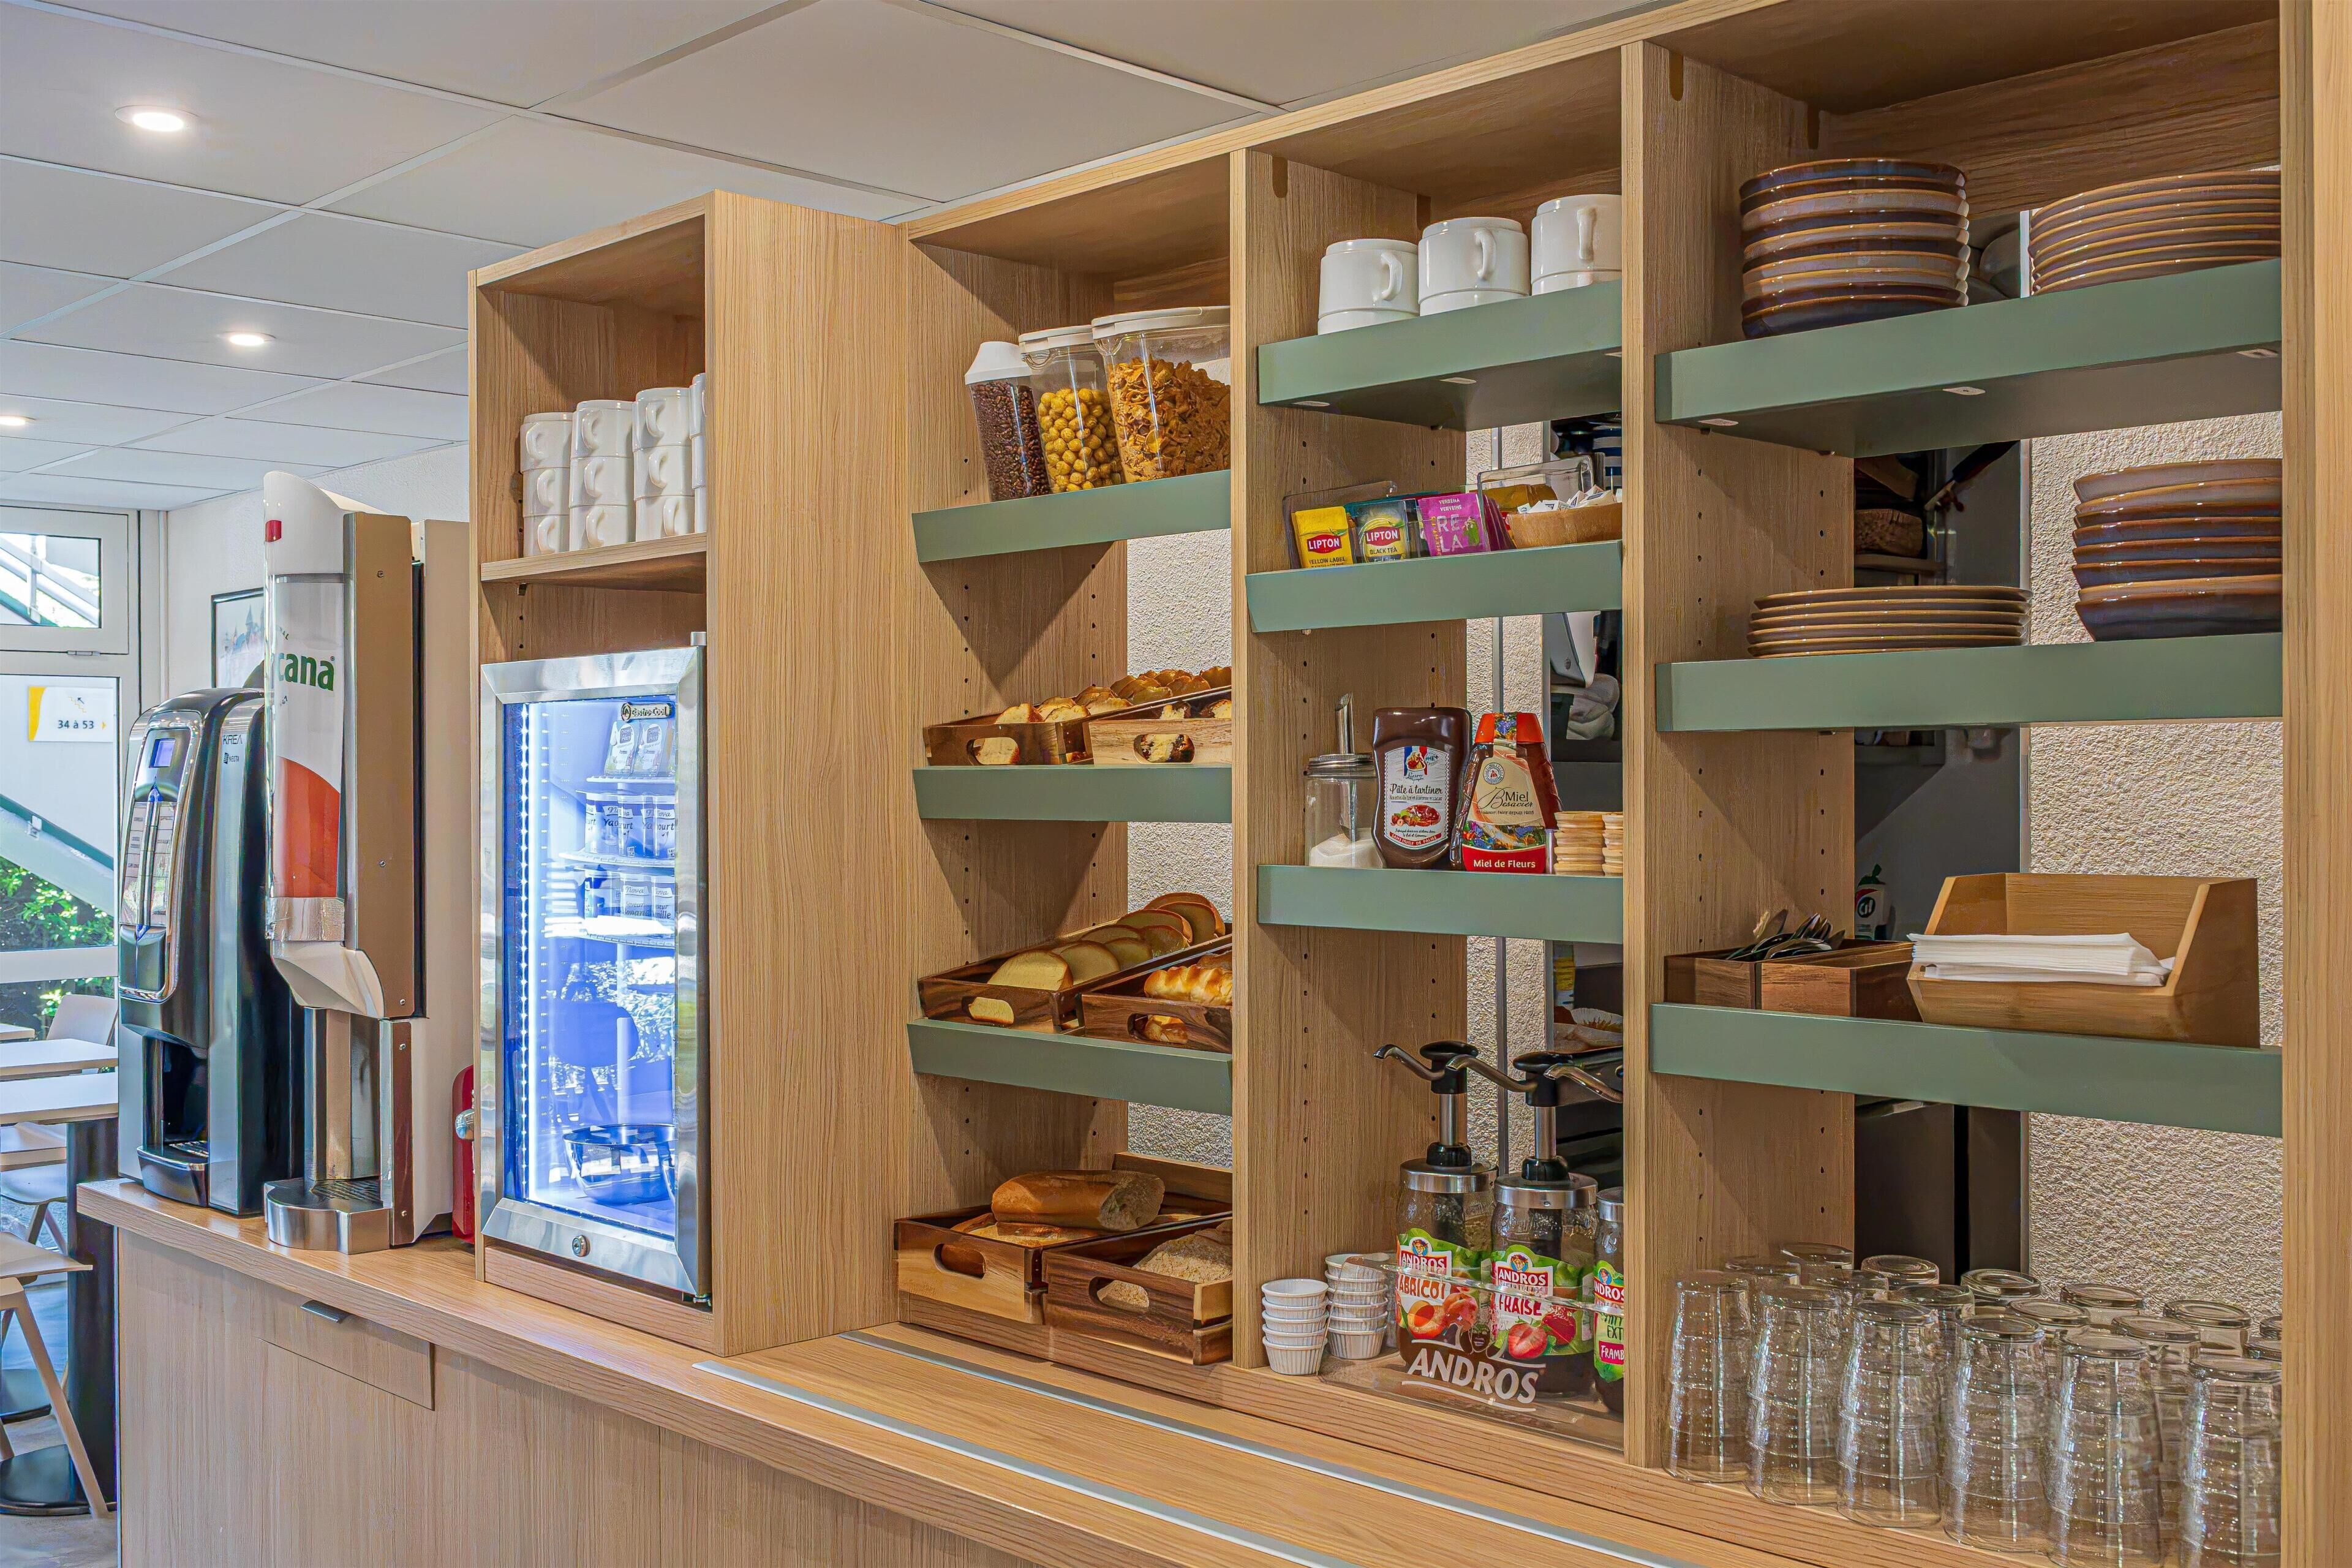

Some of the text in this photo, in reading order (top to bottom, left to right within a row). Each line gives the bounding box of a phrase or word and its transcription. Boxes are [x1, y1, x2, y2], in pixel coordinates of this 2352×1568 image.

[1365, 529, 1399, 543] LIPTON
[1308, 538, 1340, 550] LIPTON
[58, 720, 94, 729] 34 à 53
[1390, 783, 1443, 794] Pâte à tartiner
[1505, 791, 1528, 802] Miel
[1499, 1268, 1547, 1286] ANDROS
[1607, 1325, 1624, 1341] EXT
[1408, 1348, 1539, 1404] ANDROS
